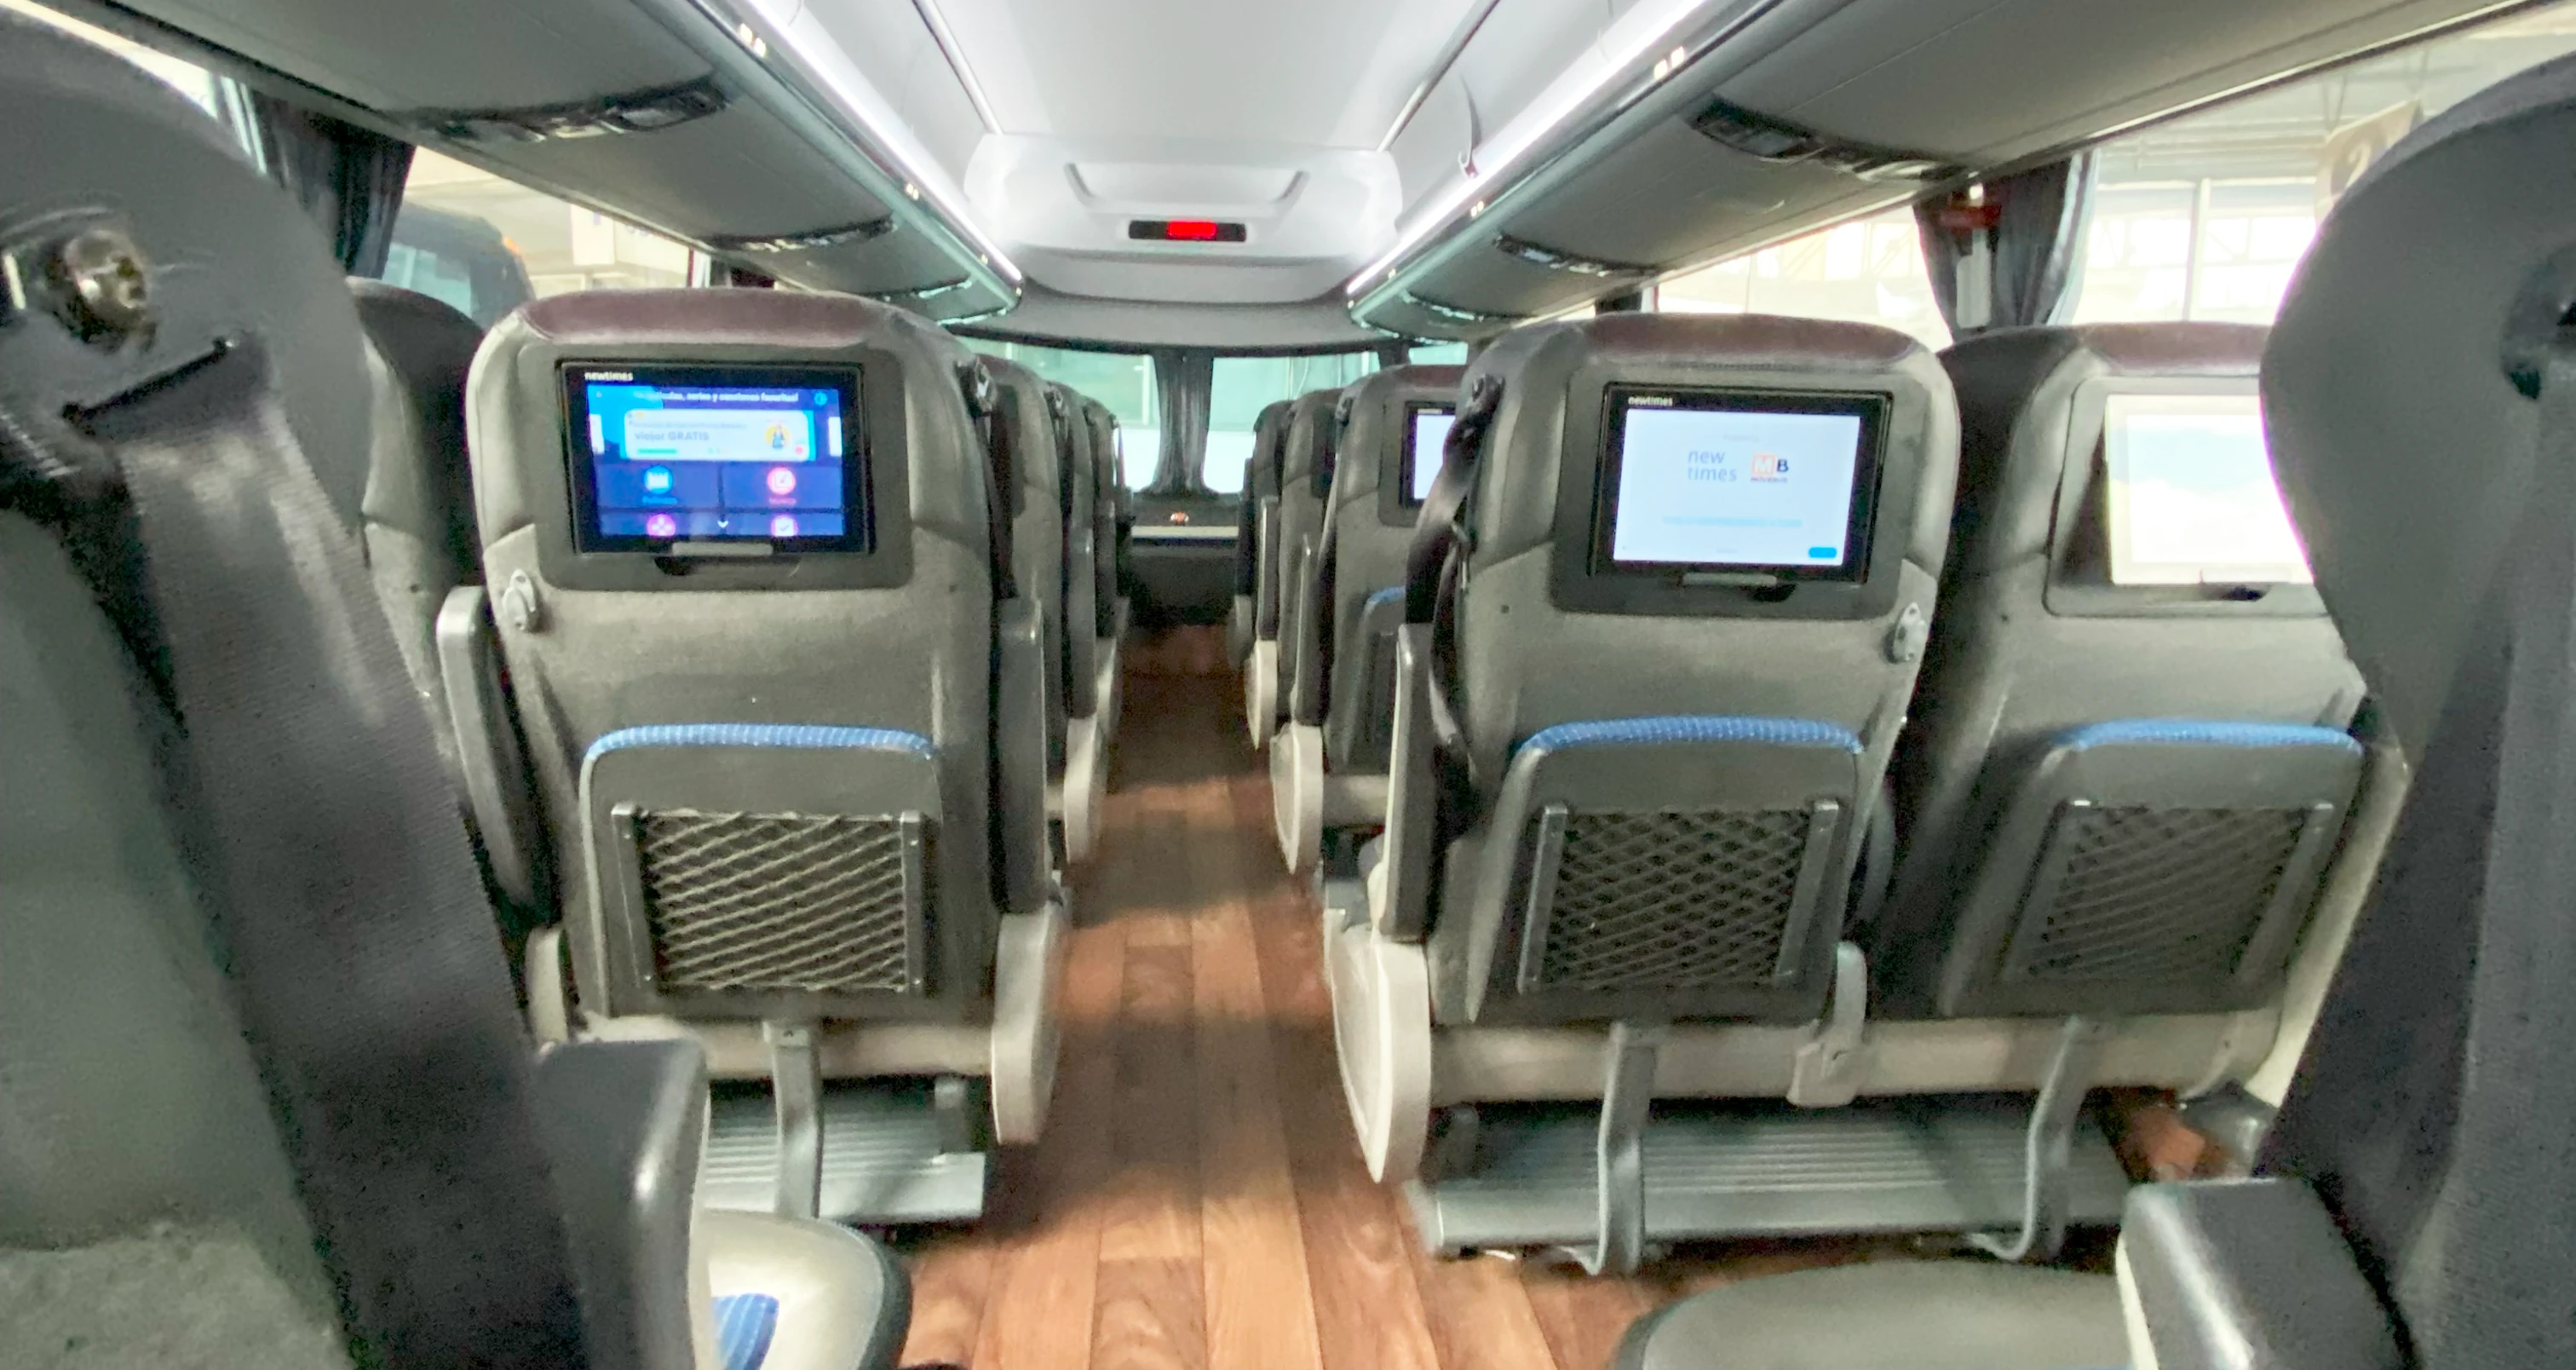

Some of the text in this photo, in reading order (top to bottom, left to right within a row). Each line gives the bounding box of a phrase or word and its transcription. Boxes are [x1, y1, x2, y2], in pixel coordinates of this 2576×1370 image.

[584, 371, 634, 382] newtimes
[1628, 396, 1673, 406] newtimes
[667, 431, 710, 441] GRATIS
[1688, 450, 1725, 464] new
[1688, 466, 1738, 482] times
